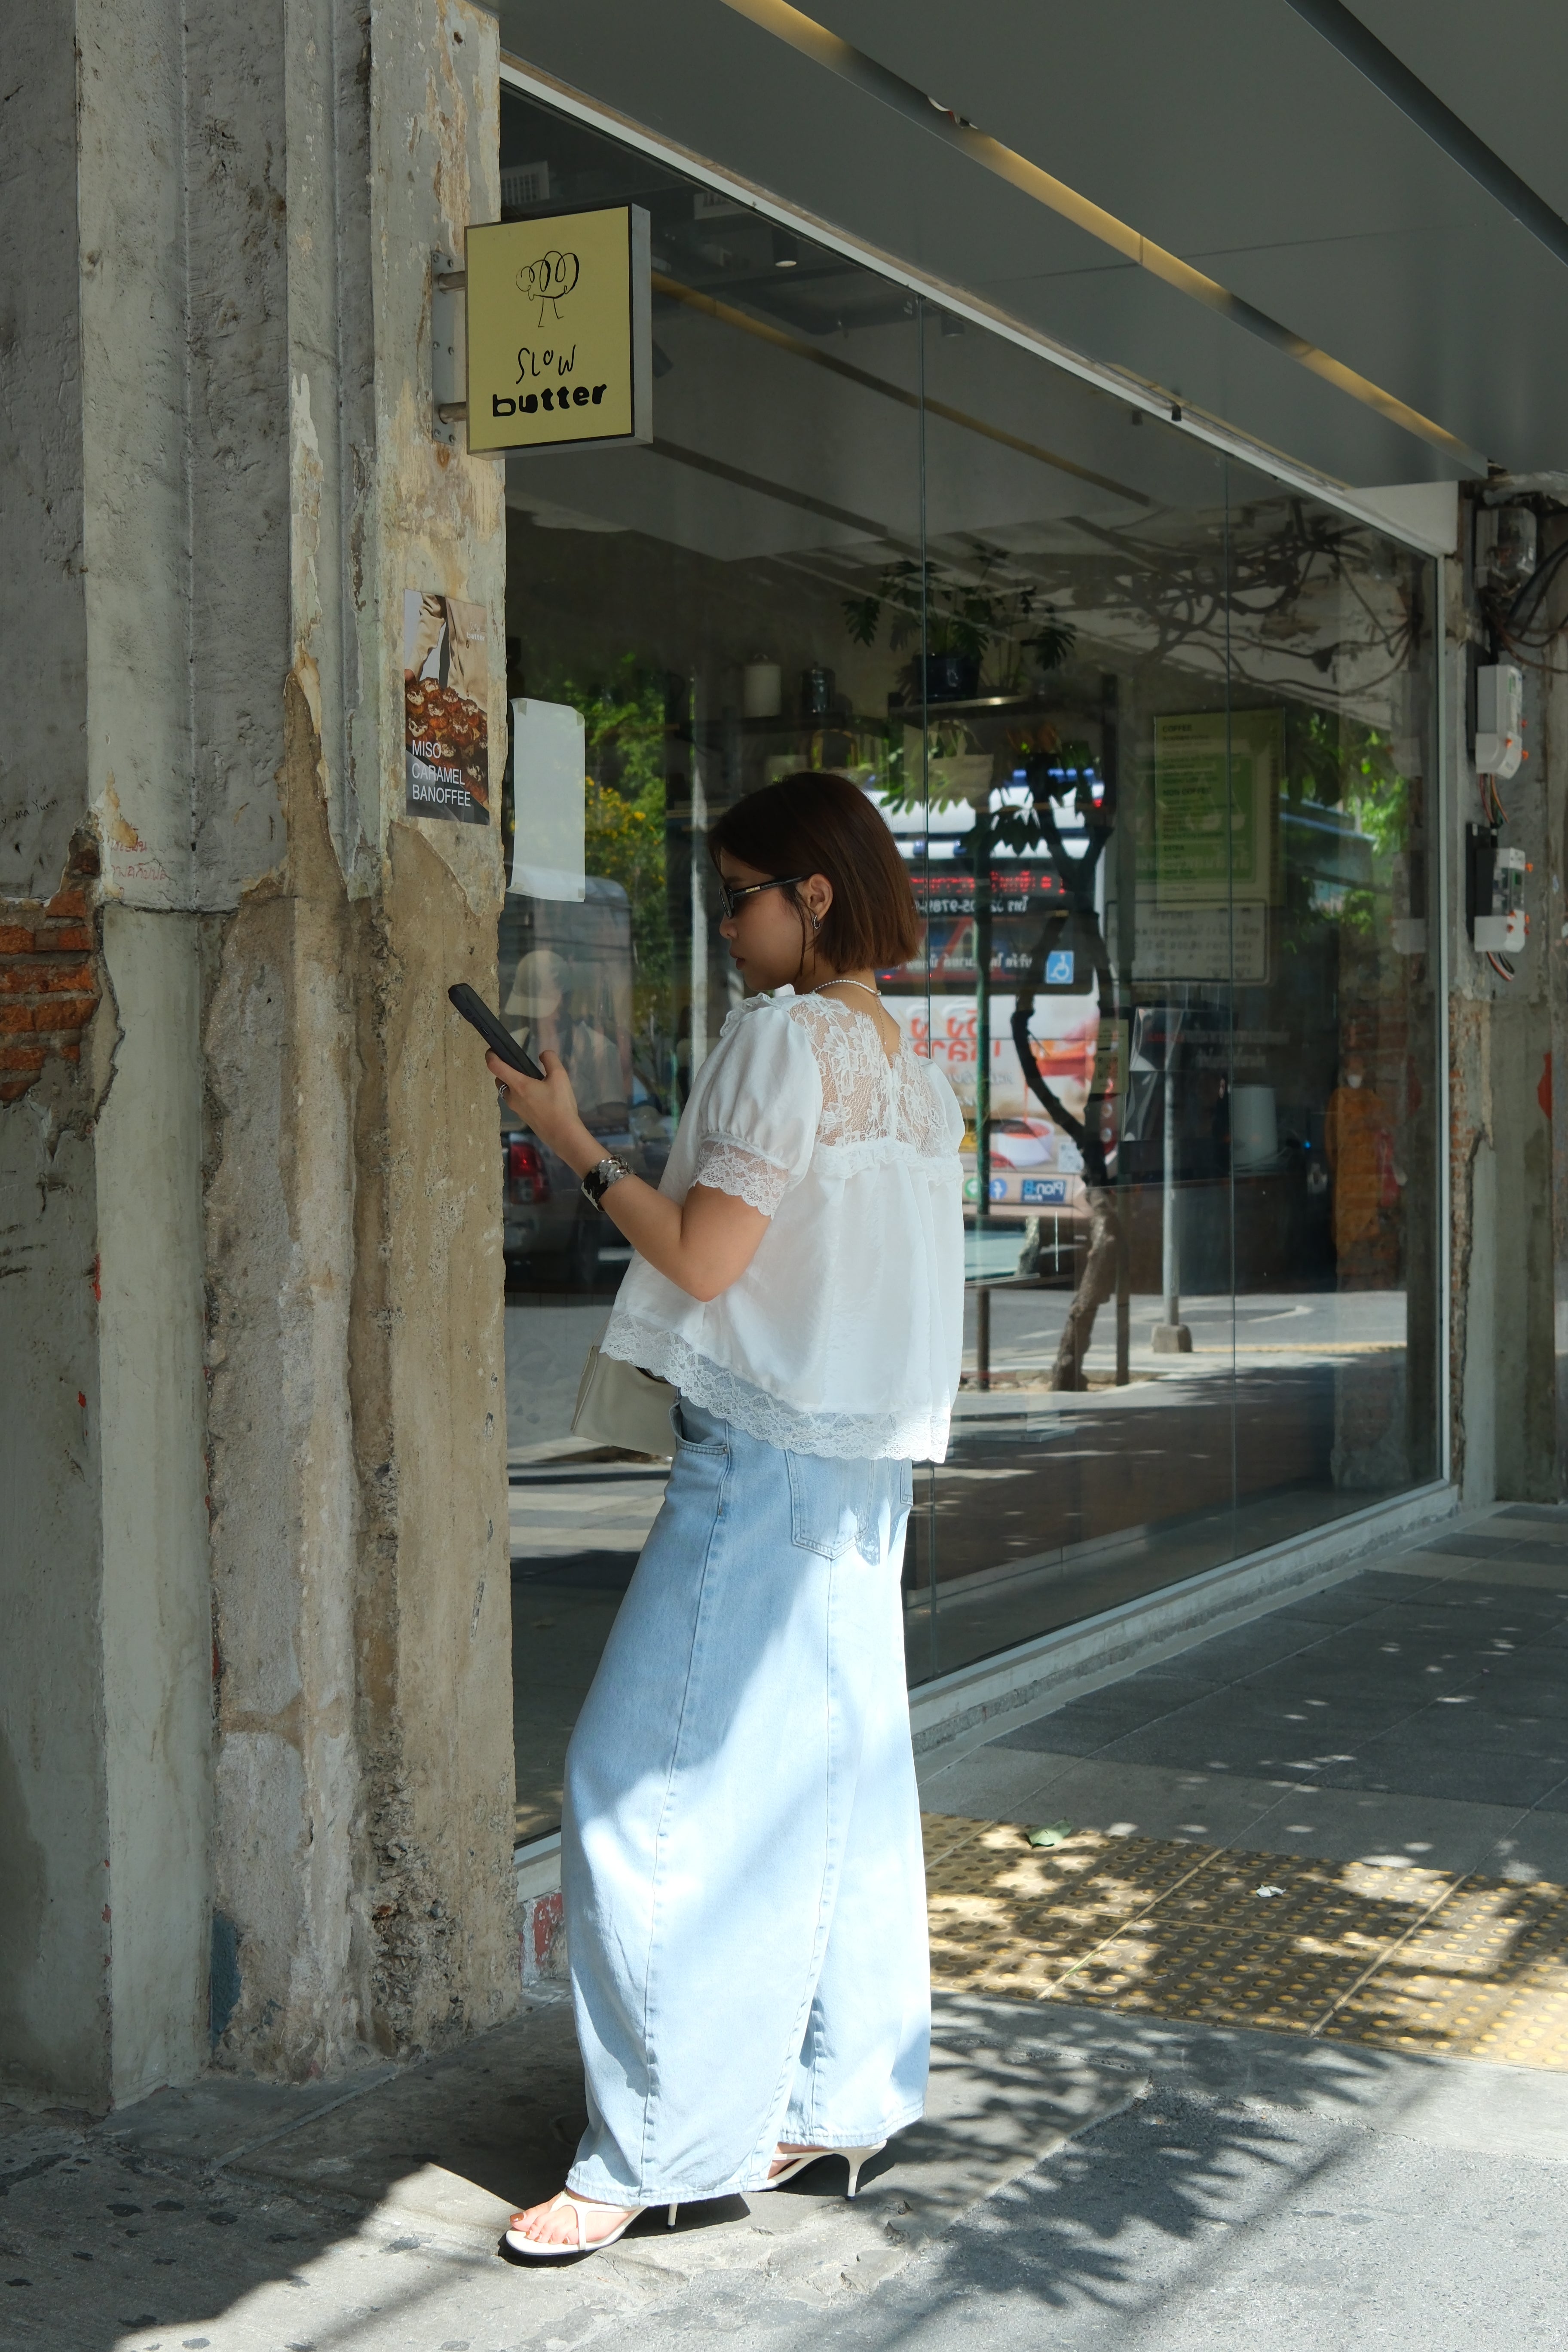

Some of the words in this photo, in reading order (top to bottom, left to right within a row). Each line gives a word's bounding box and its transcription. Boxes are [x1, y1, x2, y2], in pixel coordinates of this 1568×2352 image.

[492, 383, 607, 417] butter
[466, 631, 485, 641] butter
[412, 740, 441, 759] MISO
[411, 763, 466, 785] CARAMEL
[412, 784, 471, 807] BANOFFEE
